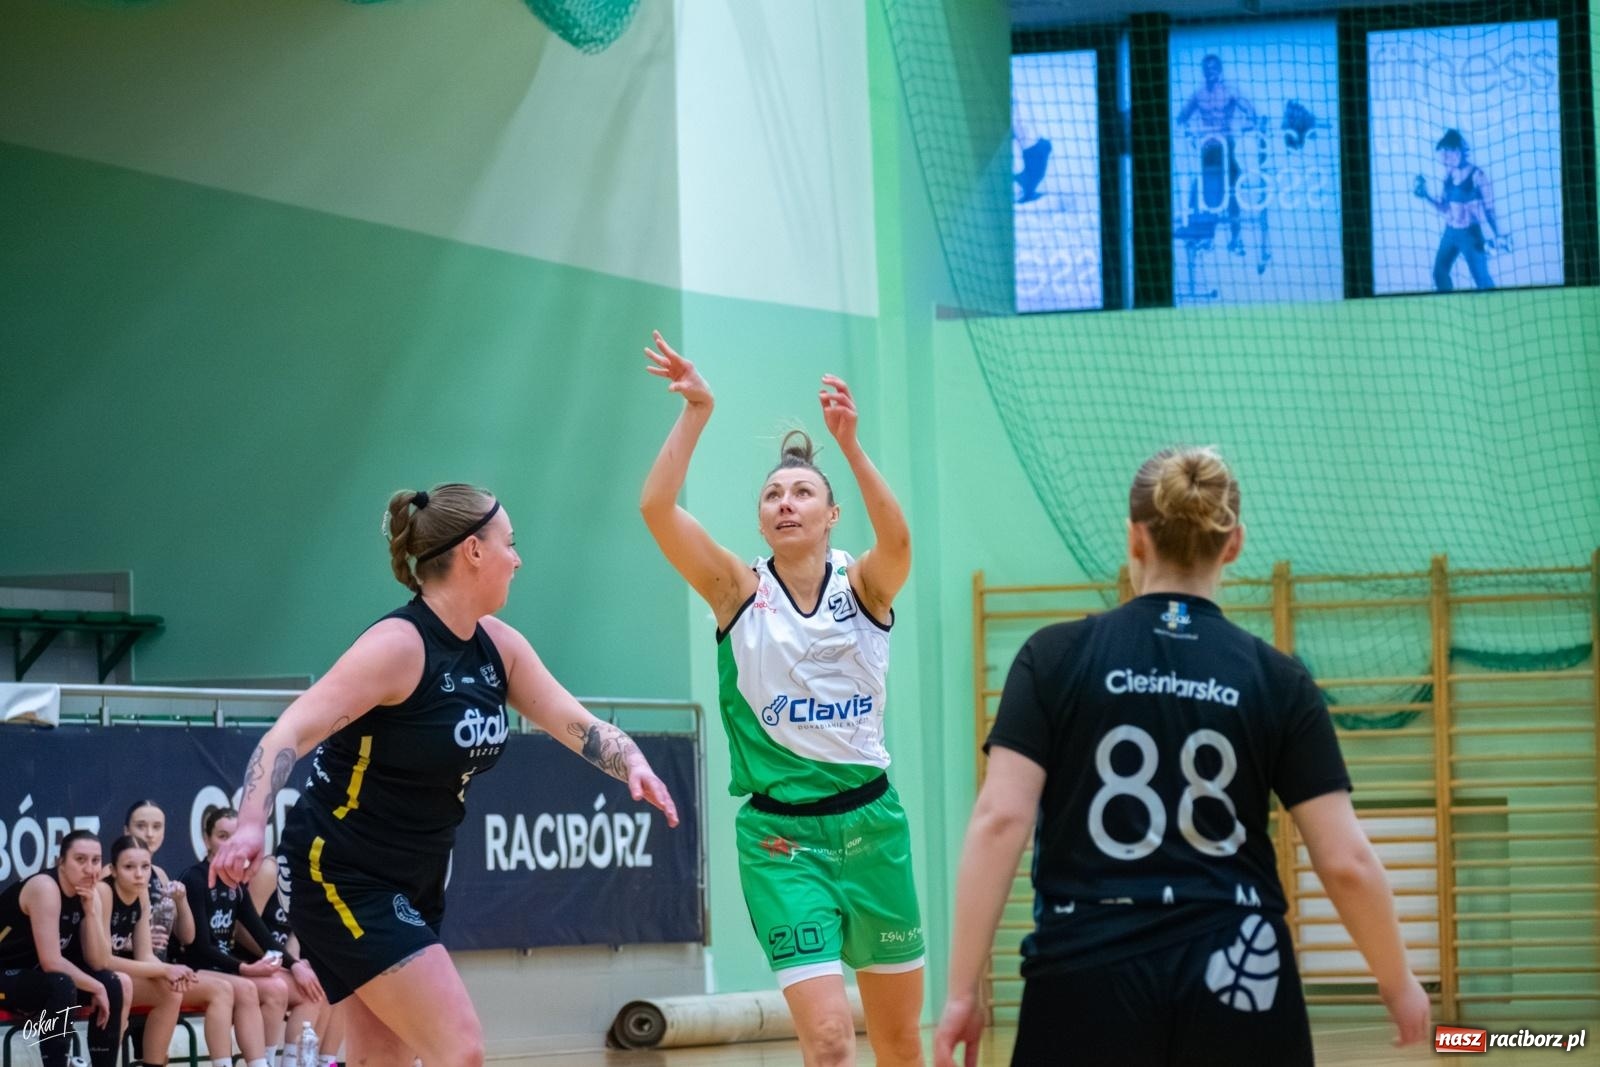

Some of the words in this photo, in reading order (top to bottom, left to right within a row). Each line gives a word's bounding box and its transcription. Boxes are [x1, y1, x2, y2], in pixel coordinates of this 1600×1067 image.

[1369, 47, 1556, 101] fitness
[789, 694, 873, 723] Clavis
[1105, 668, 1240, 707] Cieśniarska
[1088, 724, 1247, 861] 88
[485, 793, 653, 871] RACIBÓRZ
[769, 921, 826, 961] 20
